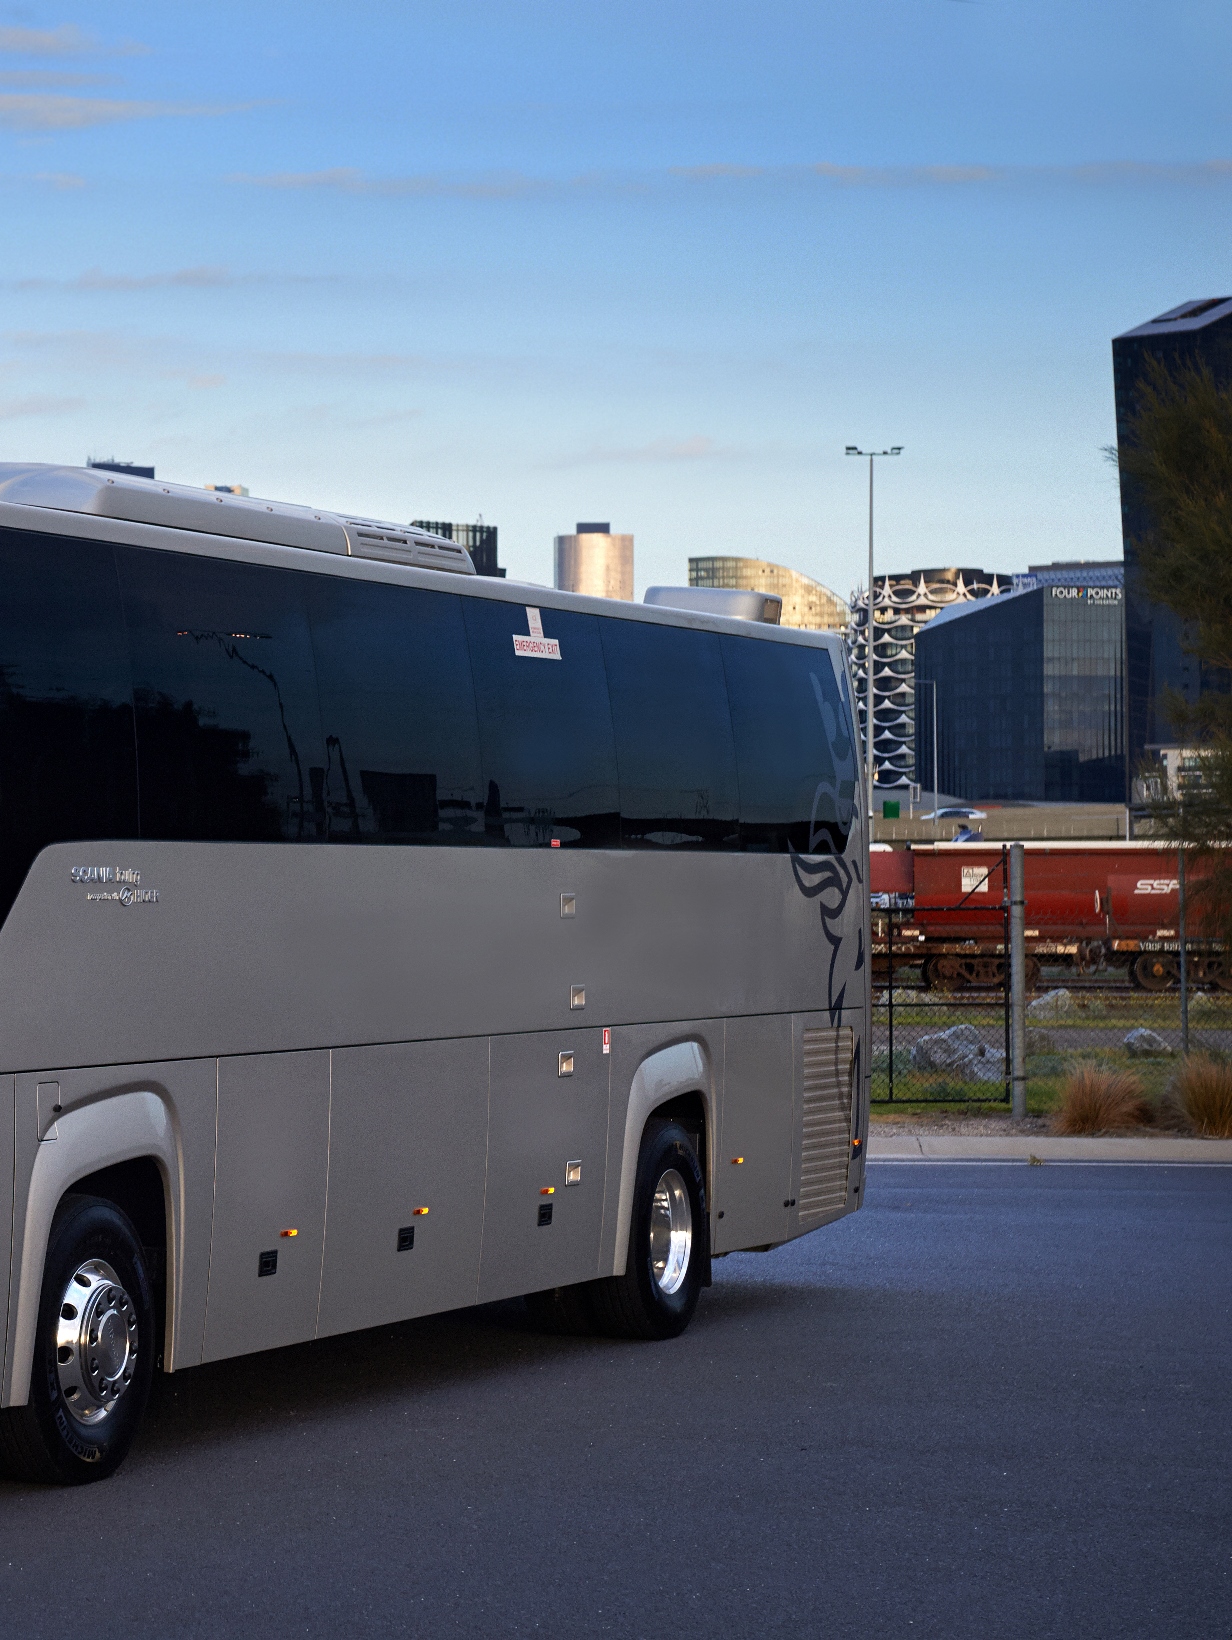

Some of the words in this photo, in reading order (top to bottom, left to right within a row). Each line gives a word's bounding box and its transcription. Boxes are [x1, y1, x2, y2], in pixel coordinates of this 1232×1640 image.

[1052, 587, 1079, 599] FOUR
[1087, 587, 1122, 599] POINTS
[514, 639, 547, 654] EMERGENCY
[547, 643, 559, 655] EXIT
[71, 866, 115, 883] SCANIA
[115, 866, 141, 887] touring
